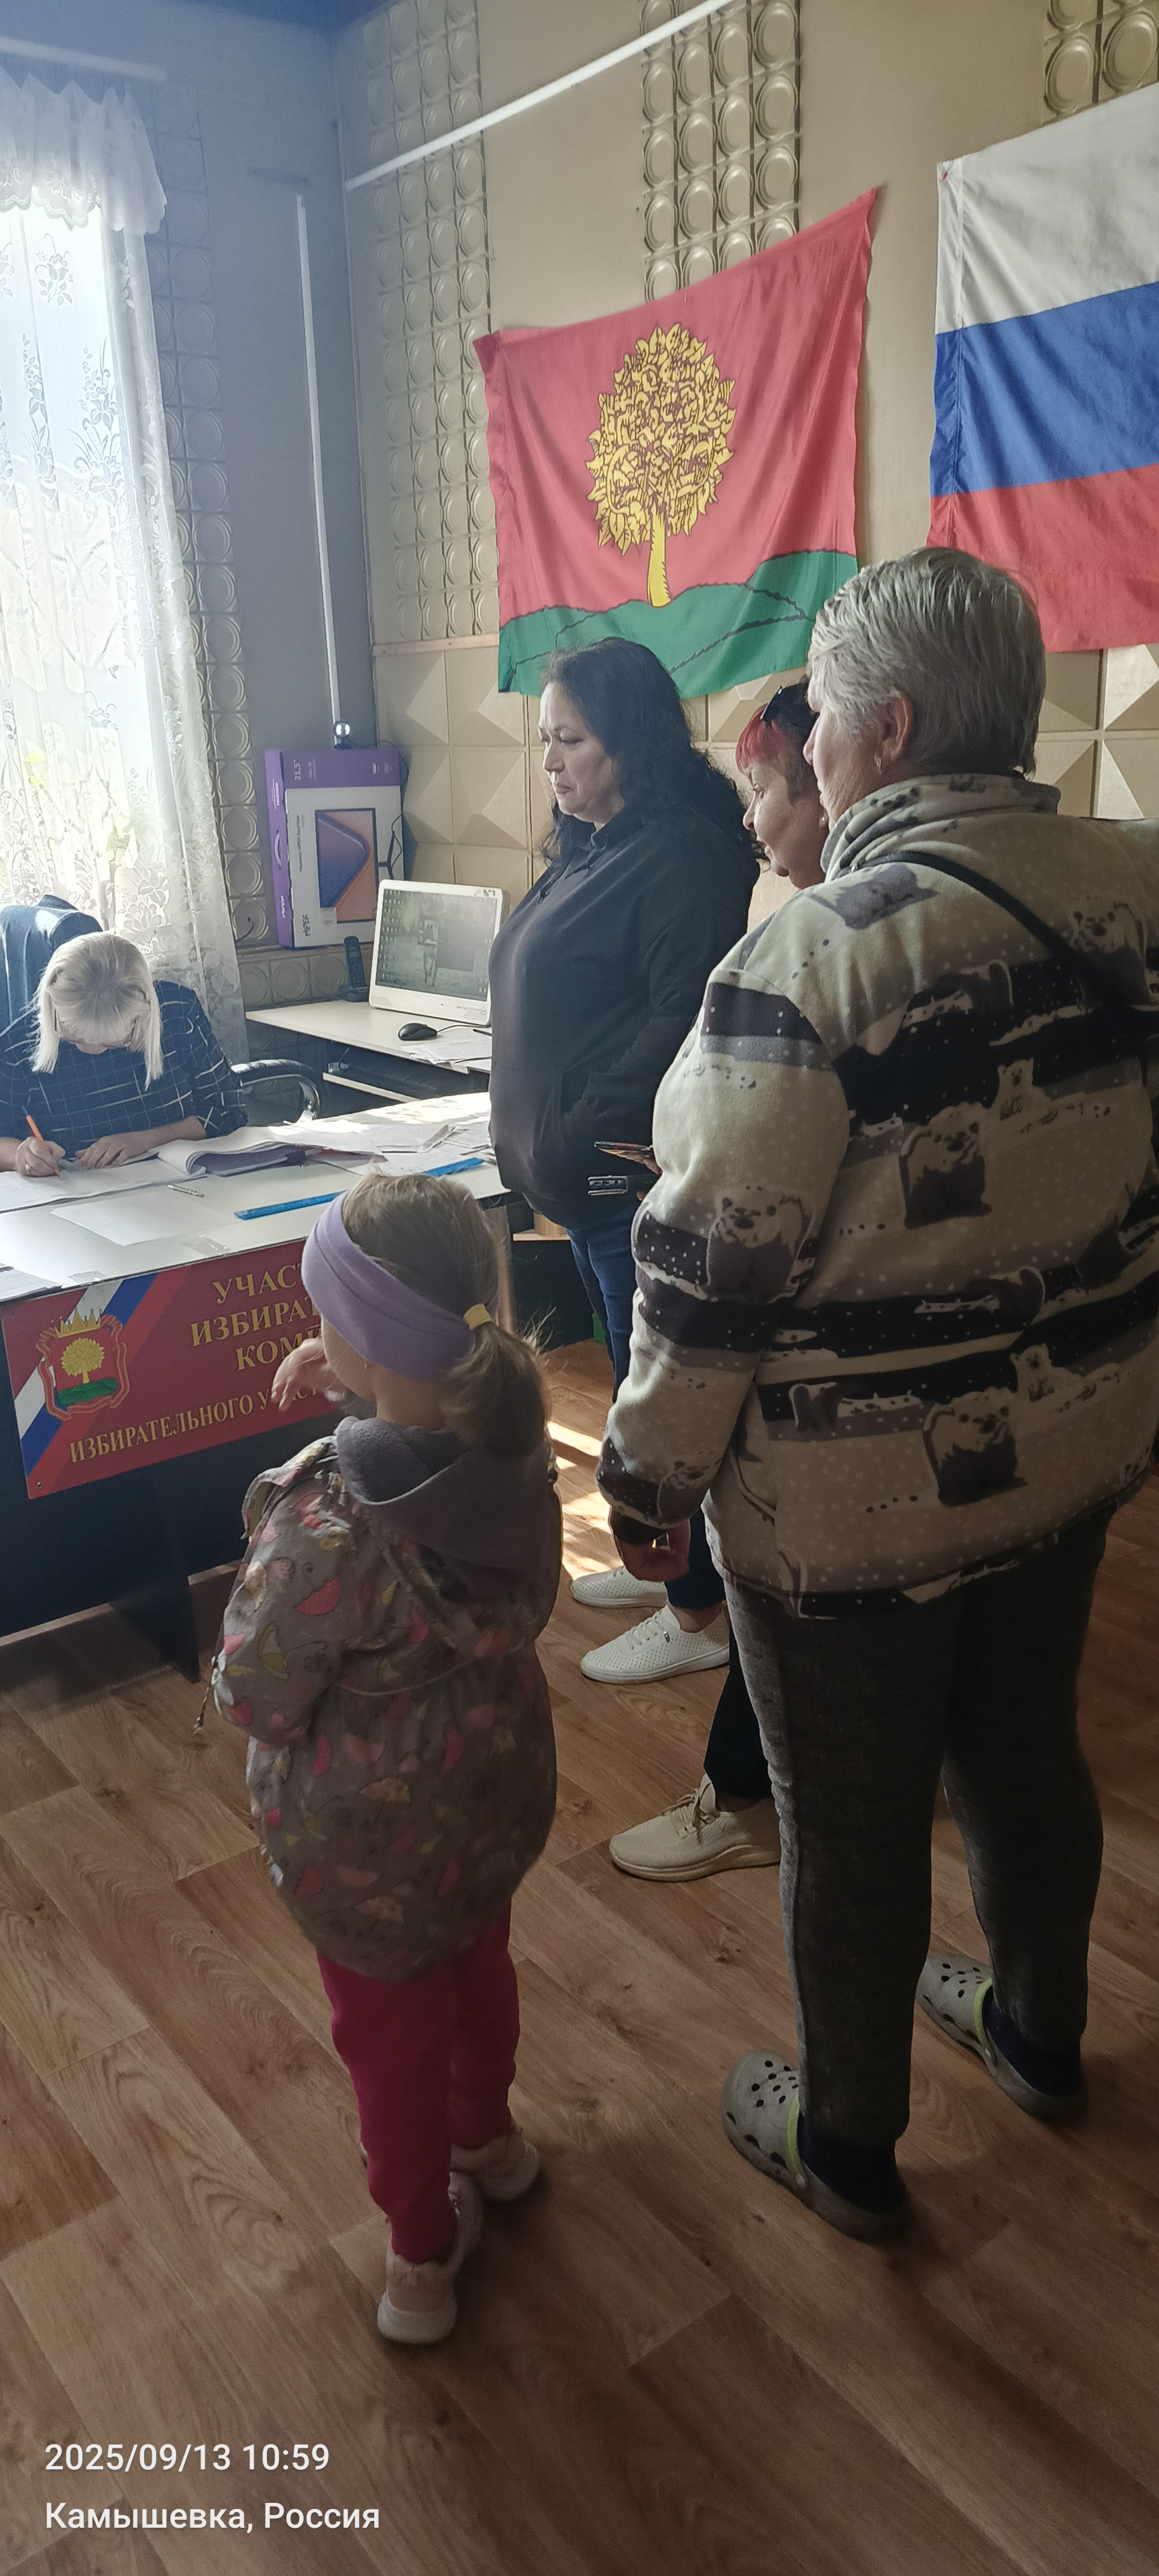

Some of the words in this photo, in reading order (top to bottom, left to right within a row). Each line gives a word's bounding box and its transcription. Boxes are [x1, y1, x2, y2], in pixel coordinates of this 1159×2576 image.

[212, 1263, 302, 1303] УЧАС
[236, 1328, 321, 1370] КОМ
[69, 1394, 253, 1463] ИЗБИРАТЕЛЬНОГО
